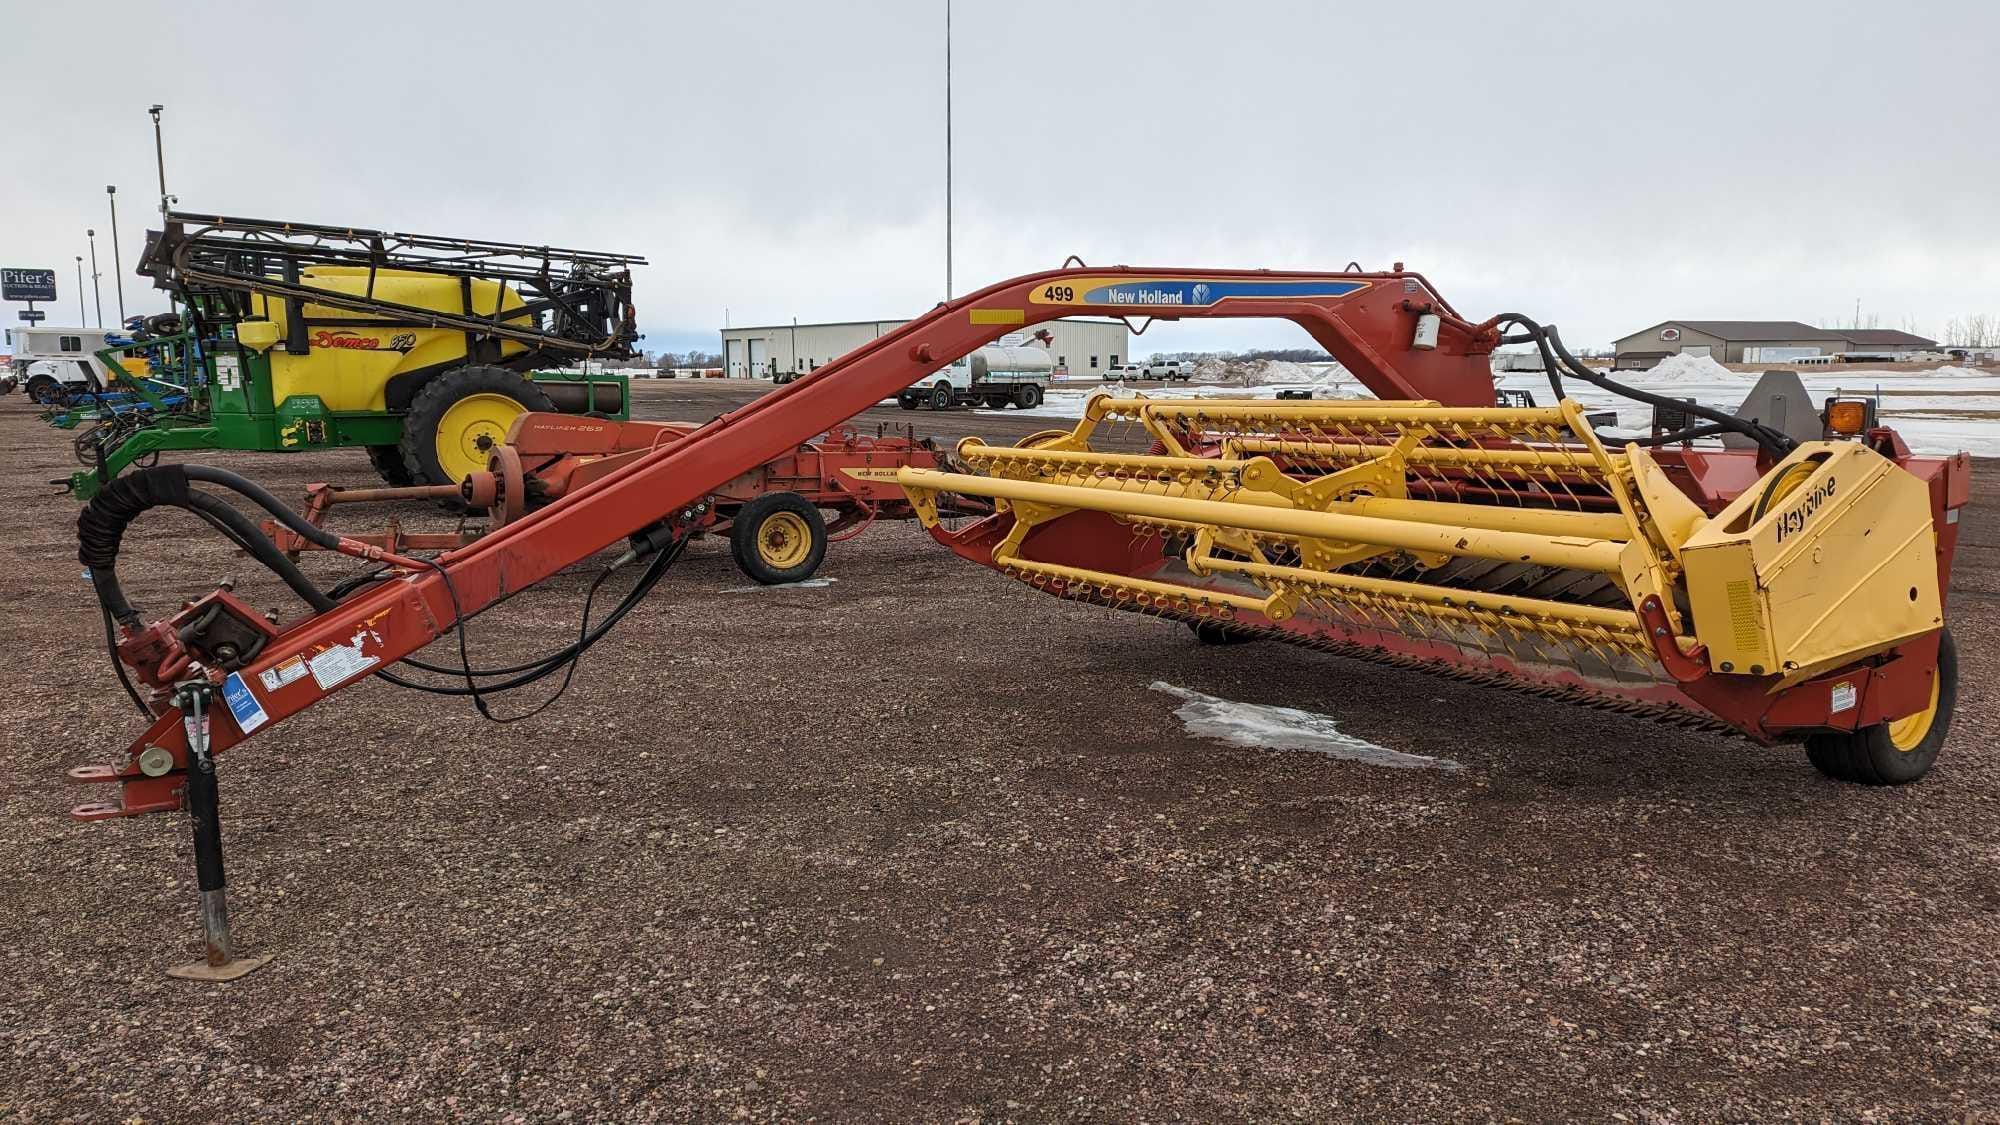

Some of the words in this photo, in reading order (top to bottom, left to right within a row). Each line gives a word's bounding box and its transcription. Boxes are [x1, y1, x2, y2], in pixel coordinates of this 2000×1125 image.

[2, 270, 54, 284] Pifer's
[1044, 286, 1074, 302] 499
[1108, 288, 1134, 304] New
[1138, 289, 1183, 305] Holland
[315, 330, 380, 348] Demco
[1776, 475, 1836, 544] Haybine
